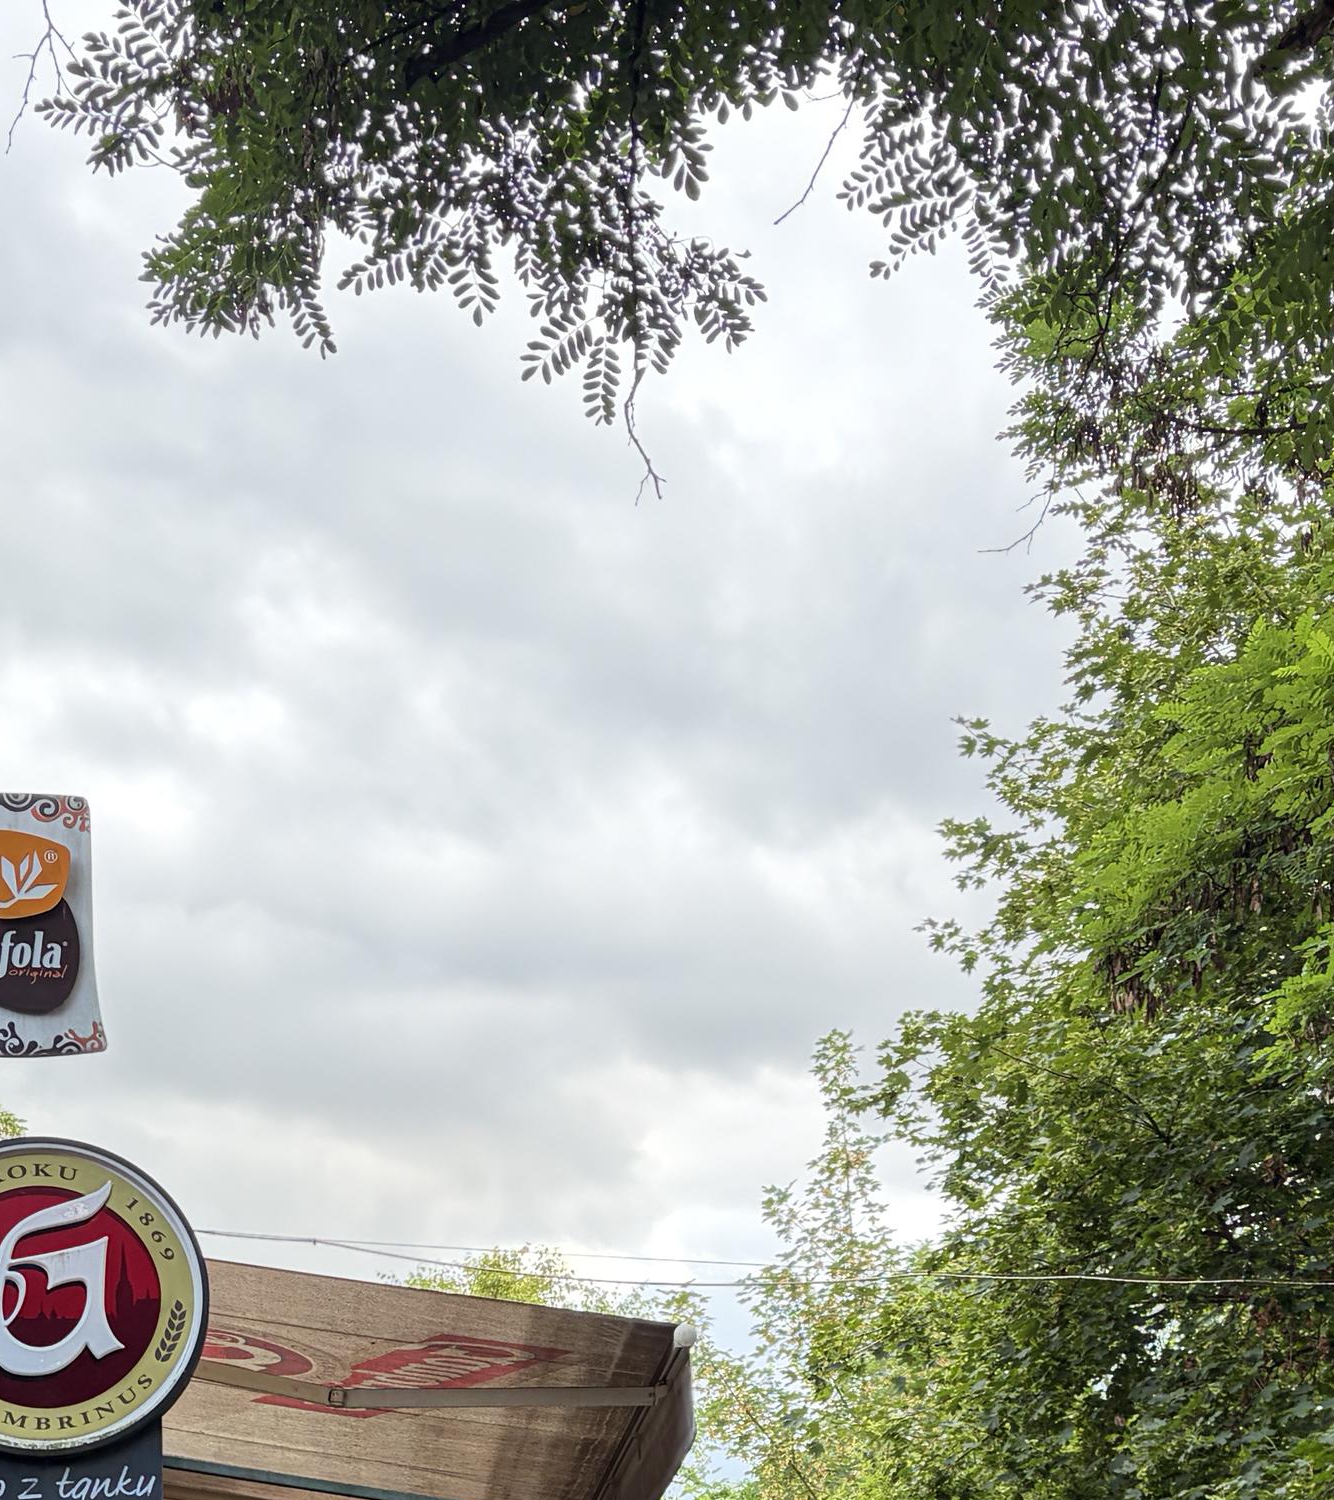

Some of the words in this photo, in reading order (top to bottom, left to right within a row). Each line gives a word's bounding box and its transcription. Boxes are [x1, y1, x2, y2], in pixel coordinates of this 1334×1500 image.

[8, 964, 68, 984] original
[125, 1197, 175, 1261] 1869
[18, 1478, 42, 1500] z
[56, 1465, 156, 1500] tanku
